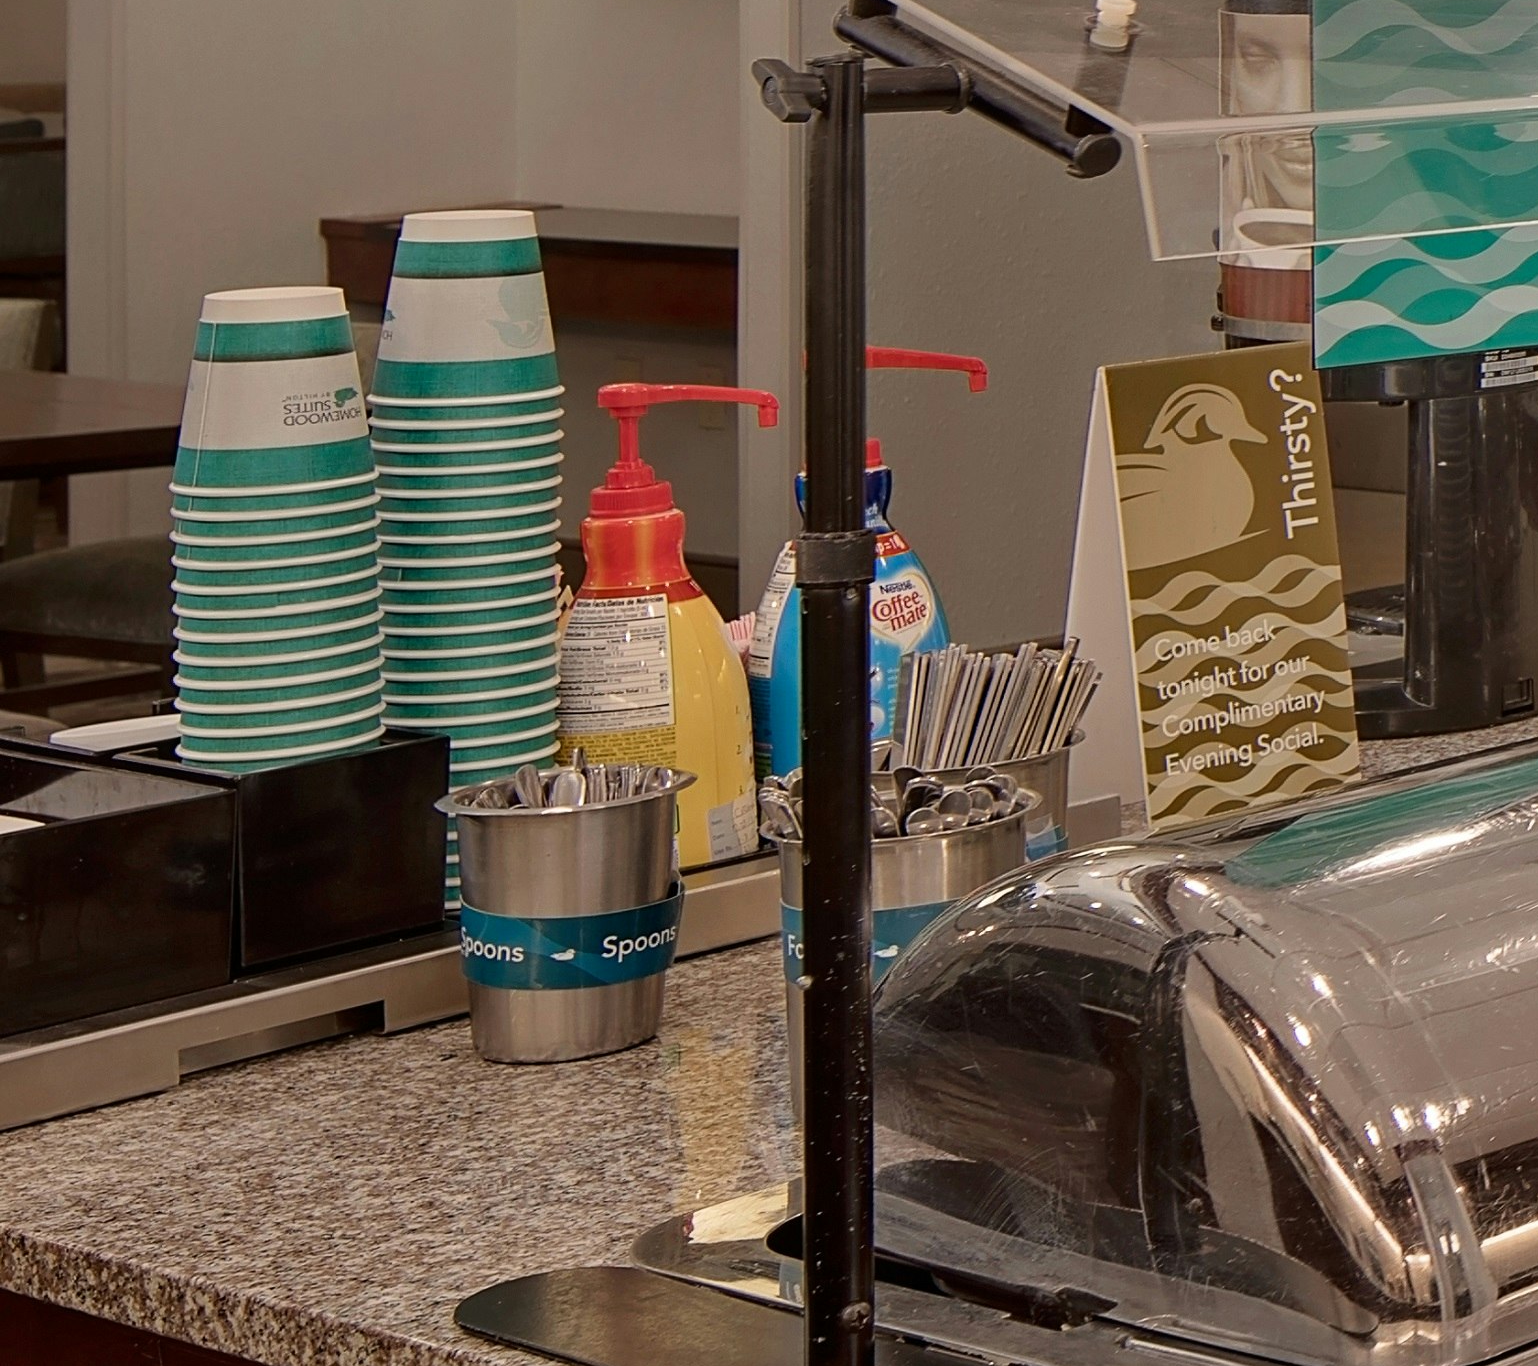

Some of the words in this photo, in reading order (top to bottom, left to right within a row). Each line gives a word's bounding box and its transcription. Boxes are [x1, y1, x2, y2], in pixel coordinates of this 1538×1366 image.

[283, 399, 331, 415] SUITES
[283, 406, 362, 426] HOMEWOOD
[1269, 368, 1319, 540] Thirsty?
[890, 603, 927, 631] mate
[1154, 634, 1220, 662] Come
[1224, 618, 1277, 648] back
[1157, 665, 1238, 700] tonight
[1239, 660, 1271, 684] for
[1274, 655, 1310, 677] our
[1162, 690, 1326, 738] Complimentary
[1165, 742, 1253, 777] Evening
[1257, 722, 1325, 757] Social.
[461, 926, 524, 963] Spoons
[601, 924, 677, 963] Spoons
